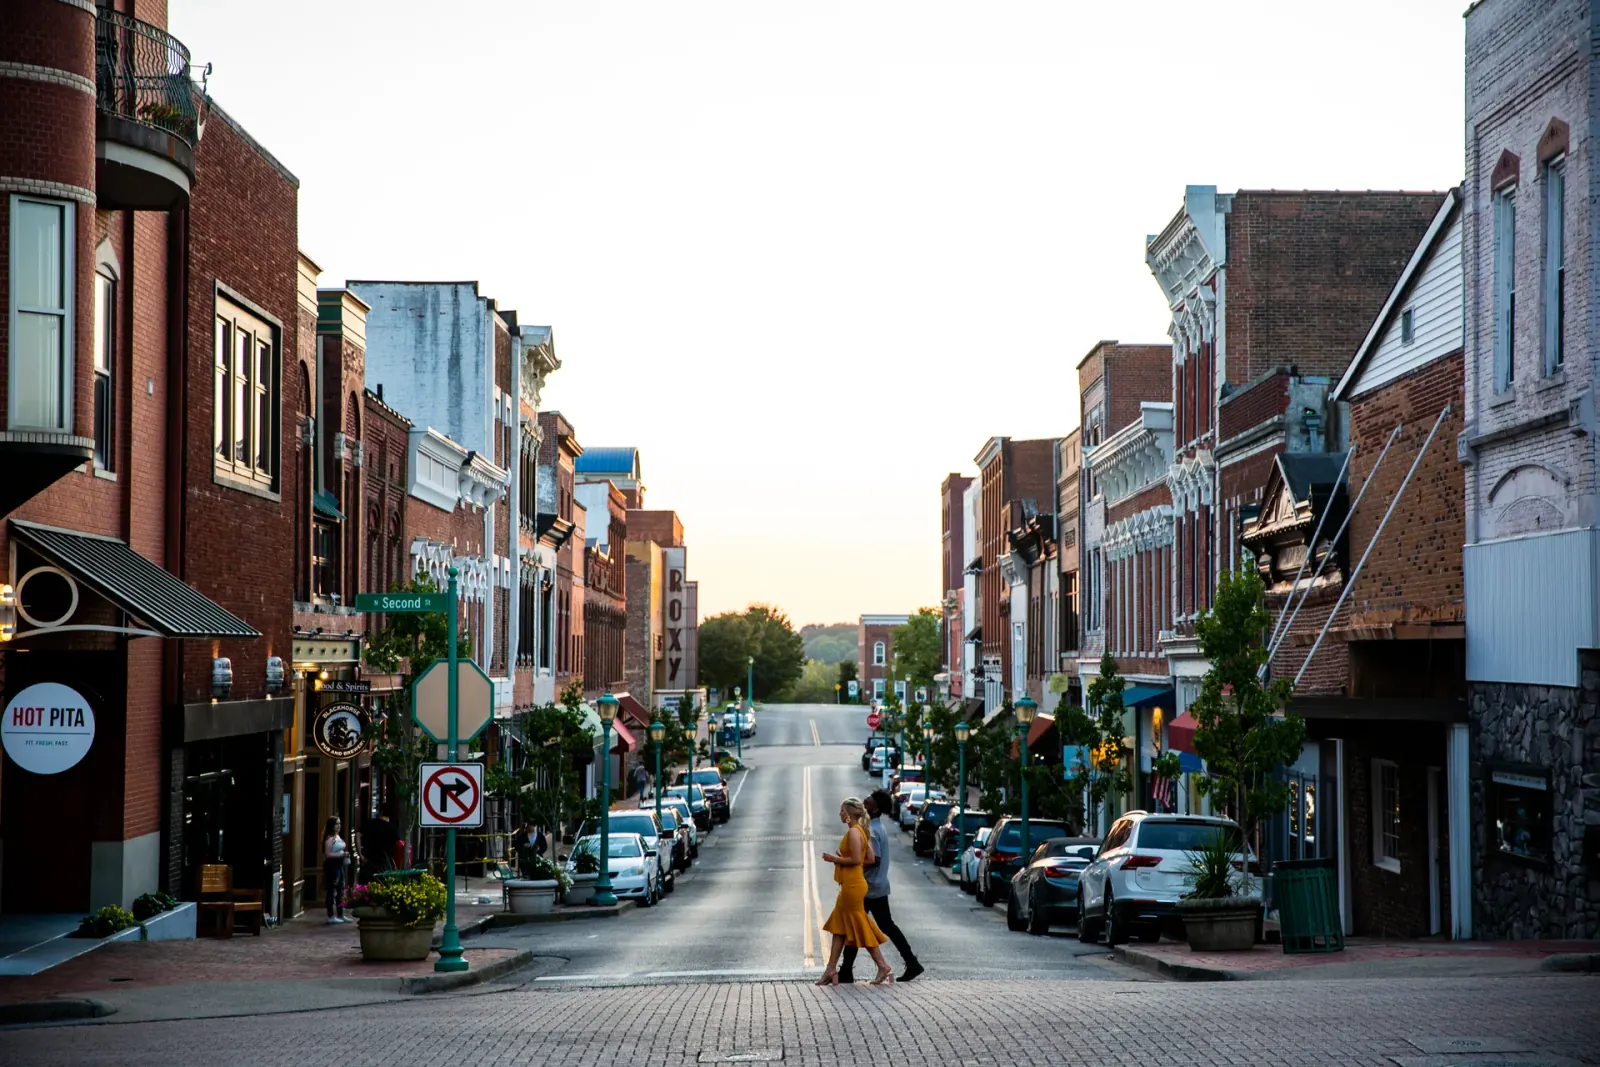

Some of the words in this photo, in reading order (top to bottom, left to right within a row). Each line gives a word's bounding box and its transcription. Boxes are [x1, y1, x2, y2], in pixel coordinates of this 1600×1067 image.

[382, 597, 421, 609] Second
[667, 569, 682, 681] ROXY
[317, 681, 335, 690] ood
[336, 682, 344, 690] &
[345, 682, 369, 692] Spirits
[13, 707, 45, 726] HOT
[49, 707, 85, 727] PITA
[322, 704, 361, 719] BLACKHORSE
[320, 741, 331, 752] PUB
[331, 749, 343, 757] AND
